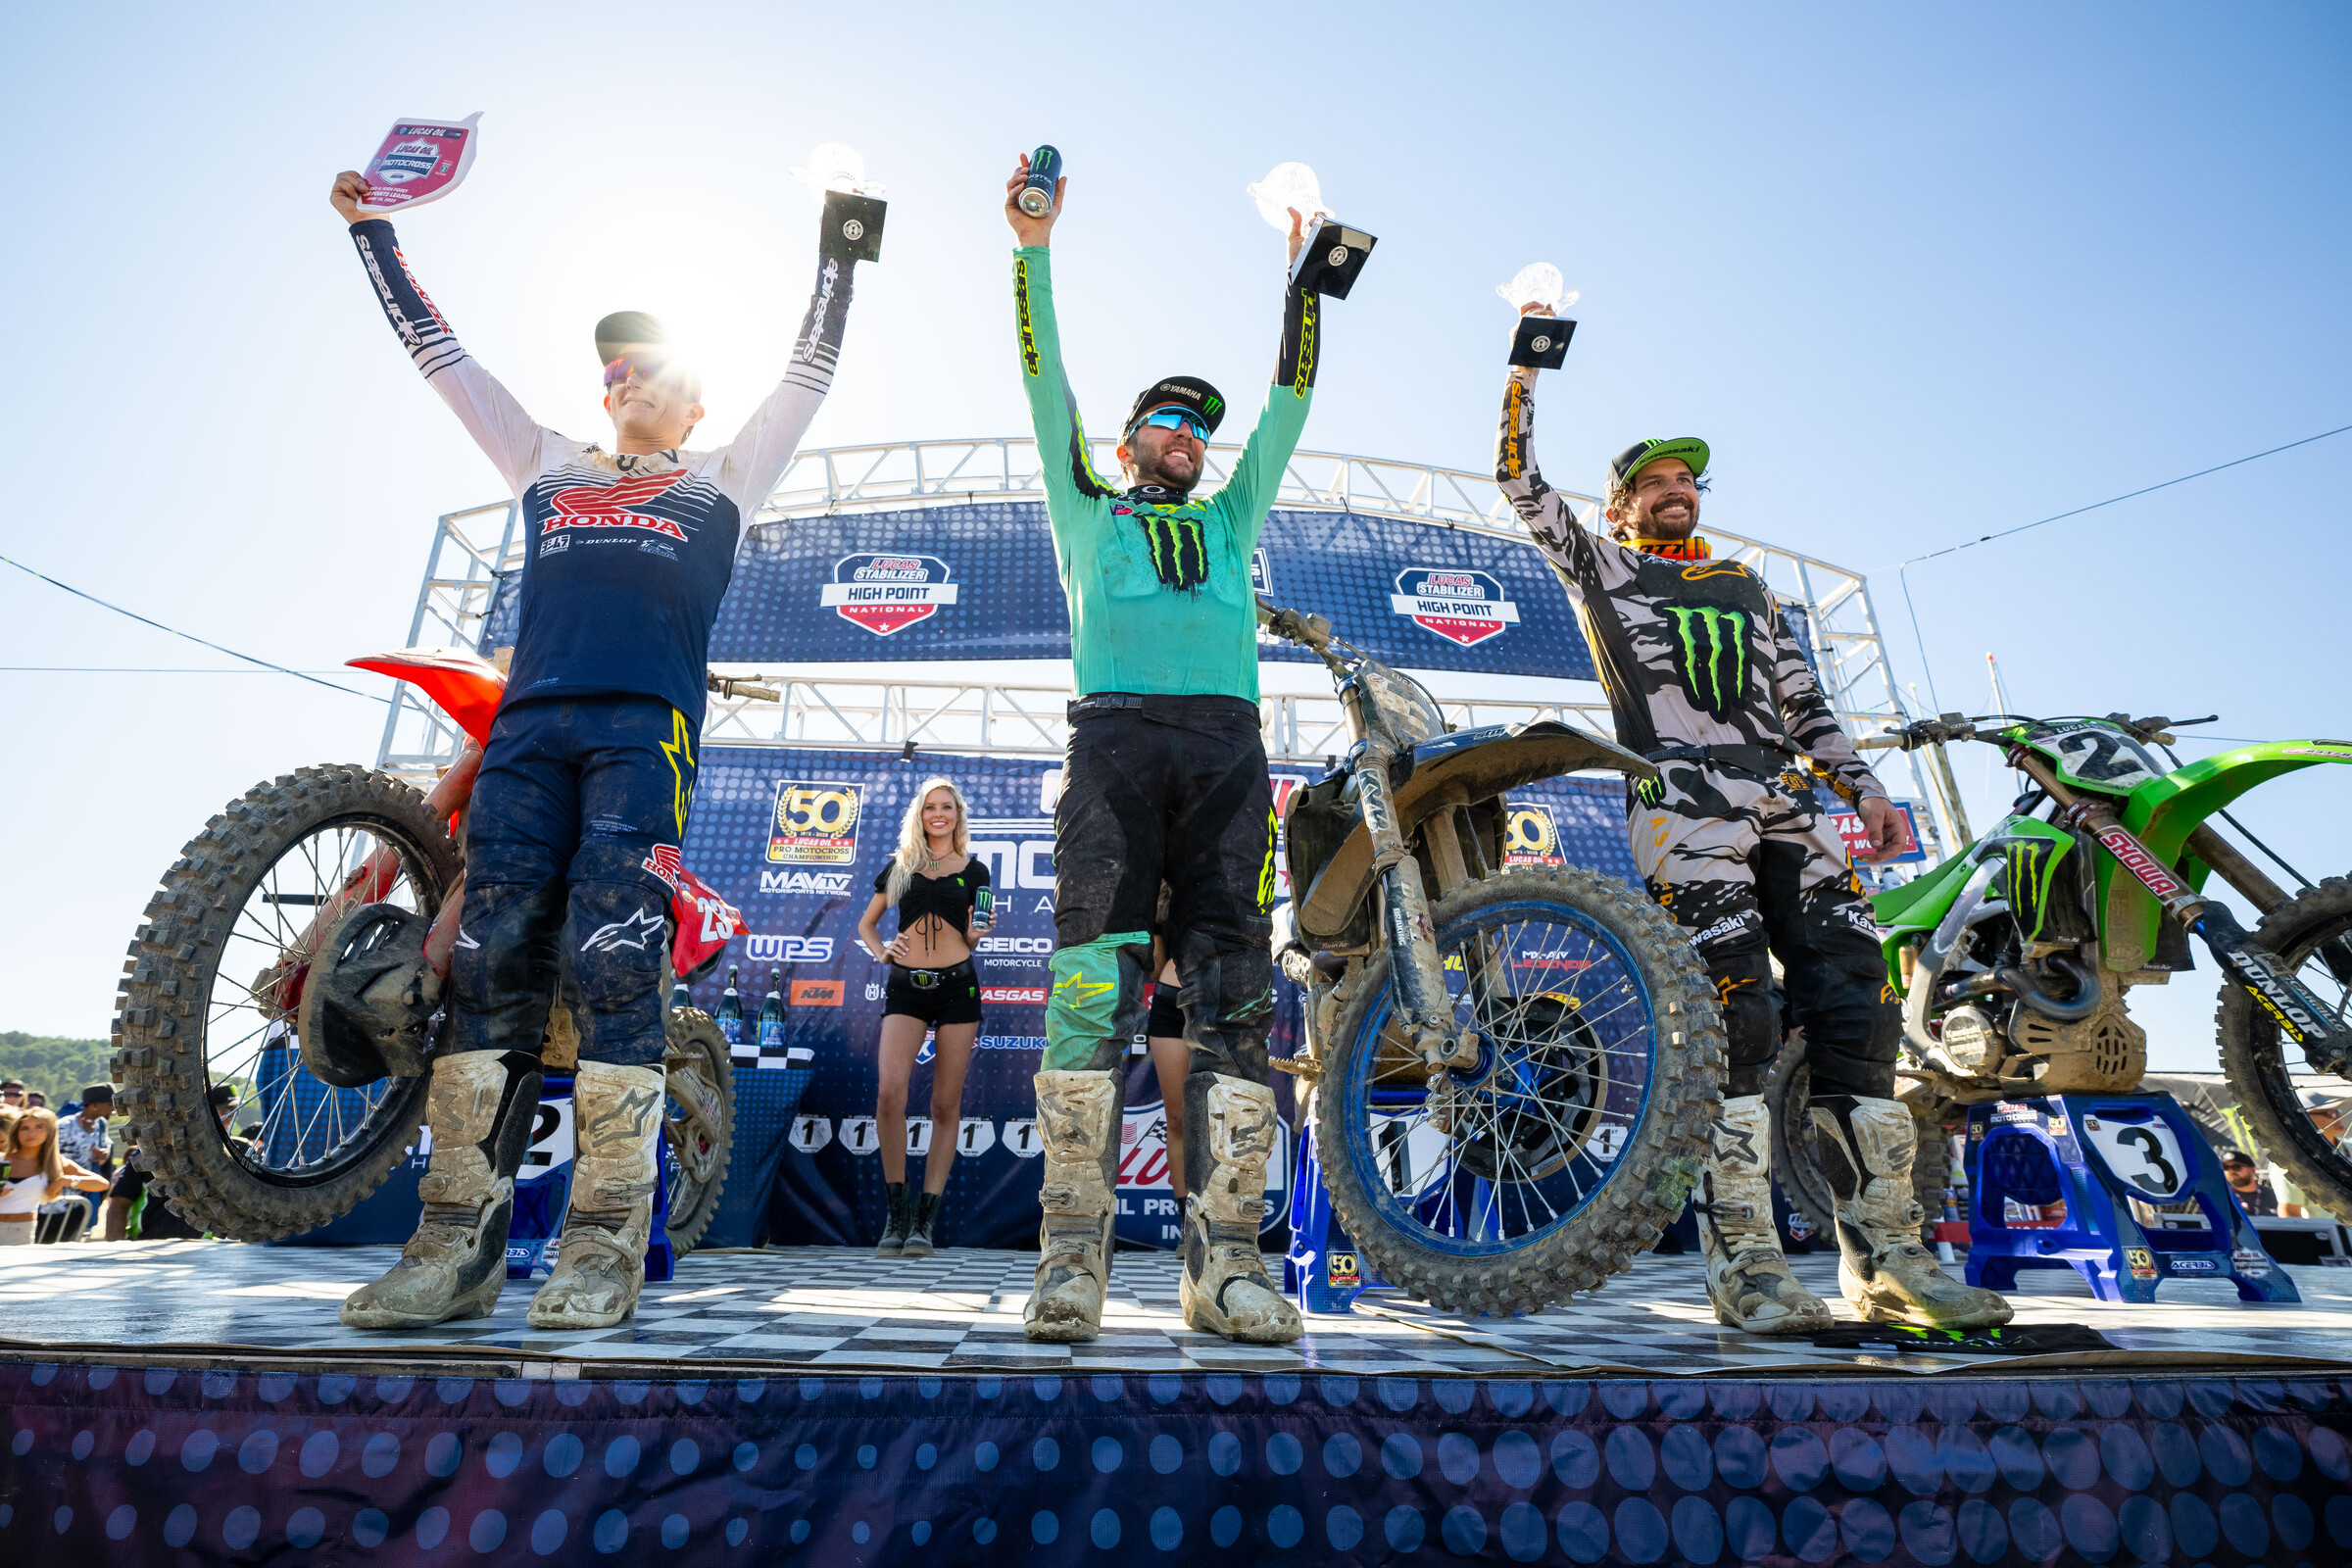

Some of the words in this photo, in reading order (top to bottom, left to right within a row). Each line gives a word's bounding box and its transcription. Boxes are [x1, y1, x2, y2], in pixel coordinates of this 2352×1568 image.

[408, 127, 432, 136] LUCAS
[432, 128, 447, 137] OIL
[396, 145, 419, 155] LUCAS
[418, 147, 434, 156] OIL
[381, 159, 433, 171] MOTOCROSS
[1029, 173, 1053, 186] NSTER
[356, 234, 422, 346] alpinestars
[802, 257, 838, 363] alpinestars
[1013, 258, 1040, 377] alpinestars
[1295, 288, 1319, 399] pinestars
[1170, 385, 1201, 400] YAMAHA
[1505, 380, 1522, 479] alpinestars
[540, 514, 688, 543] HONDA
[1641, 543, 1685, 555] OTT
[871, 560, 919, 570] LUCAS
[856, 568, 926, 581] STABILIZER
[1431, 574, 1471, 587] LUCAS
[848, 587, 882, 600] HIGH
[886, 587, 930, 600] POINT
[1419, 583, 1484, 599] STABILIZER
[1419, 600, 1449, 613] HIGH
[1452, 603, 1493, 616] POINT
[1424, 616, 1495, 629] NATIONAL
[785, 789, 851, 833] 50
[2099, 832, 2180, 897] SHOWA
[641, 858, 678, 890] HOND
[760, 870, 854, 891] MAVTV
[697, 896, 735, 943] 23
[1393, 907, 1406, 947] BRAKING
[1689, 913, 1745, 948] wasaki
[748, 936, 833, 962] WPS
[975, 937, 1053, 954] GEICO
[984, 958, 1042, 967] MOTORCYCLE
[1512, 958, 1592, 971] LEGENDS
[1522, 951, 1568, 960] MX-ATV
[801, 987, 835, 999] KTM
[2228, 951, 2327, 1039] DUNLOP
[2245, 985, 2304, 1043] ACERBIS
[2288, 979, 2346, 1033] CARRILLO
[1971, 1124, 1983, 1134] 50
[2049, 1117, 2064, 1129] 50
[1017, 1124, 1036, 1150] 1S
[1378, 1121, 1413, 1195] 1
[2117, 1127, 2179, 1194] 3
[1116, 1200, 1135, 1215] IL
[1333, 1254, 1356, 1274] 50
[2127, 1248, 2148, 1268] 50
[2171, 1260, 2215, 1270] ACERBIS
